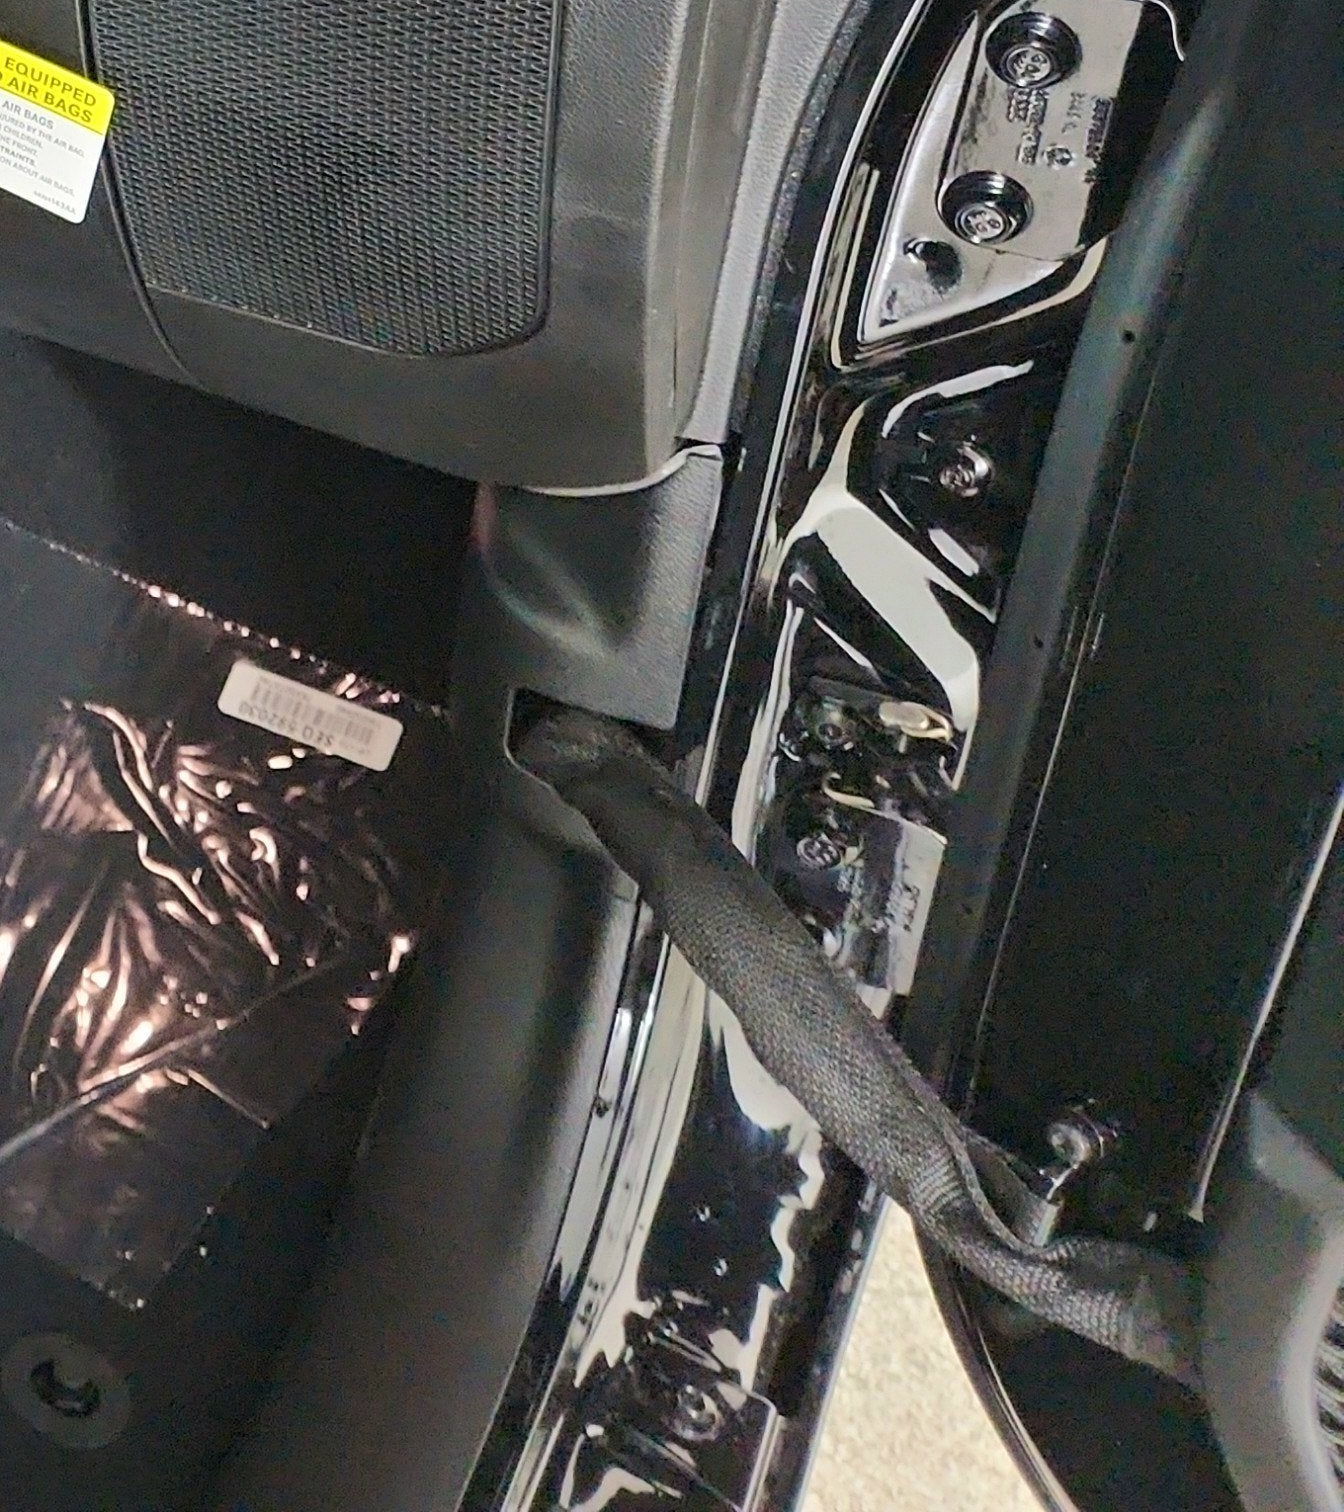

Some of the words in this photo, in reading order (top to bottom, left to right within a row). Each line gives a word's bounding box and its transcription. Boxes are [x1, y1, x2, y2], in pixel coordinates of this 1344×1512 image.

[4, 56, 97, 108] EQUIPPED
[7, 75, 39, 99] AIR
[43, 91, 92, 123] BAGS
[1, 99, 21, 114] AIR
[23, 108, 54, 130] BAGS
[12, 162, 38, 179] ABOUT
